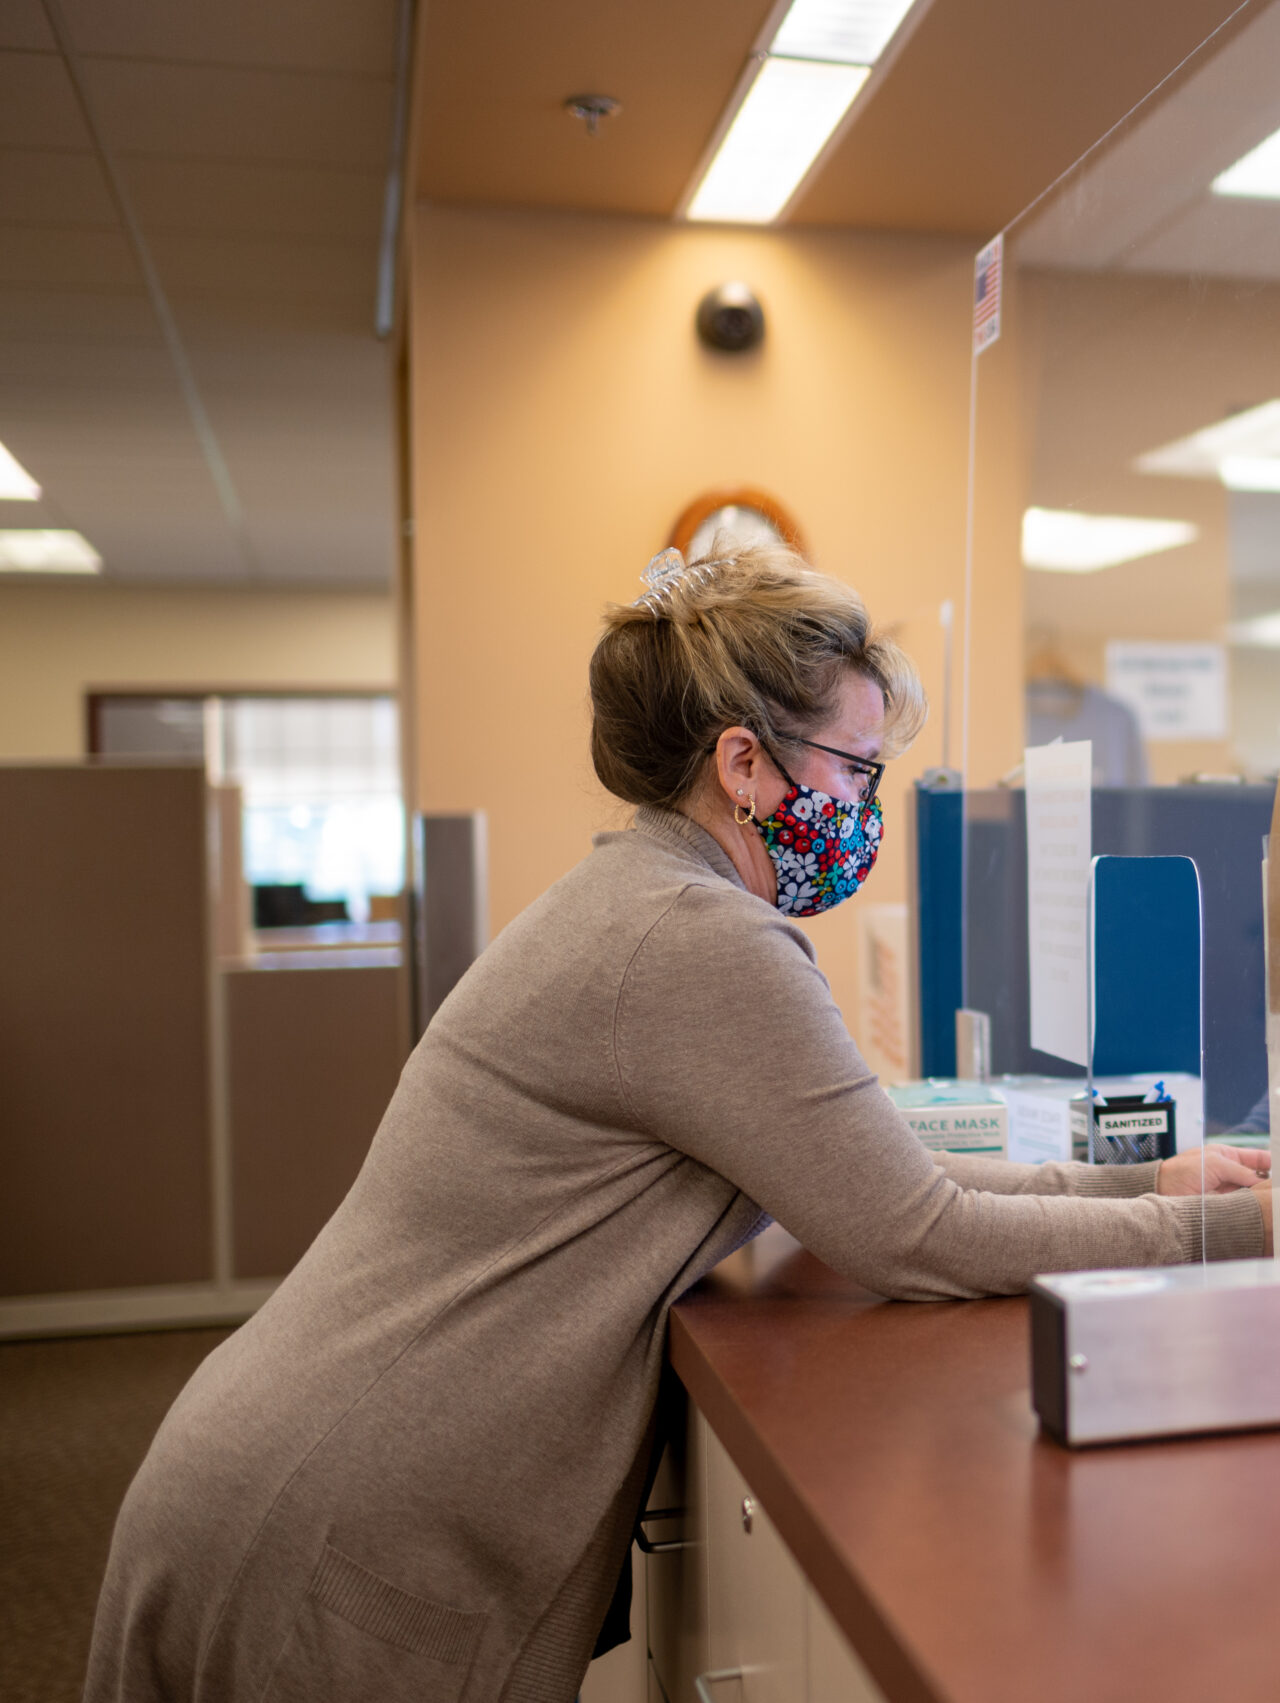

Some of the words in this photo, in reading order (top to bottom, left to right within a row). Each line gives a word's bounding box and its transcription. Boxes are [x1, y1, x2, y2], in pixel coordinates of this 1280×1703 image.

[909, 1119, 949, 1132] FACE
[954, 1118, 1000, 1130] MASK
[1105, 1118, 1162, 1130] SANITIZED
